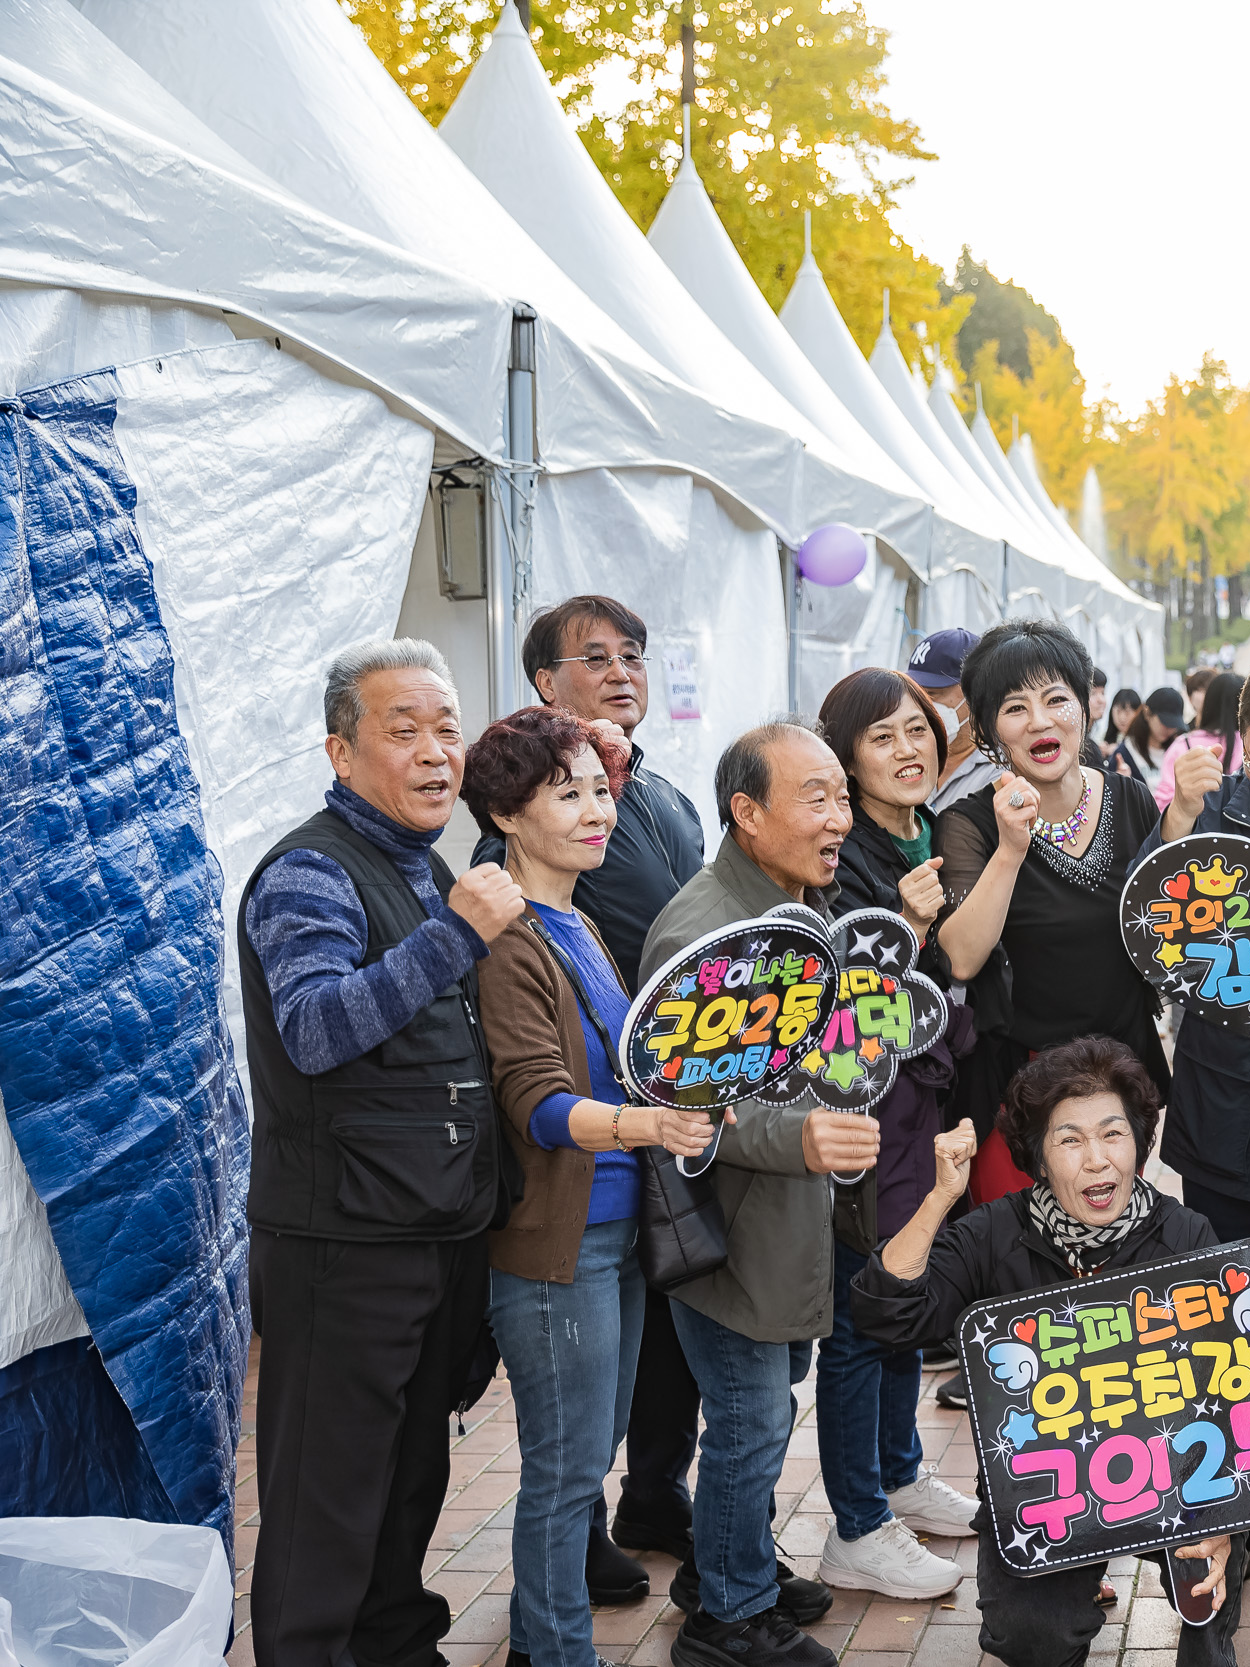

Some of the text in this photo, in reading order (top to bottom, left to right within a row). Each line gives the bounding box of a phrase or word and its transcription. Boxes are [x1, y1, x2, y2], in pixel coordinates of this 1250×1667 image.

[699, 952, 804, 996] 빛이나는
[647, 984, 823, 1061] 구의2동
[679, 1046, 771, 1085] 파이팅
[1039, 1285, 1229, 1369] 슈퍼스타
